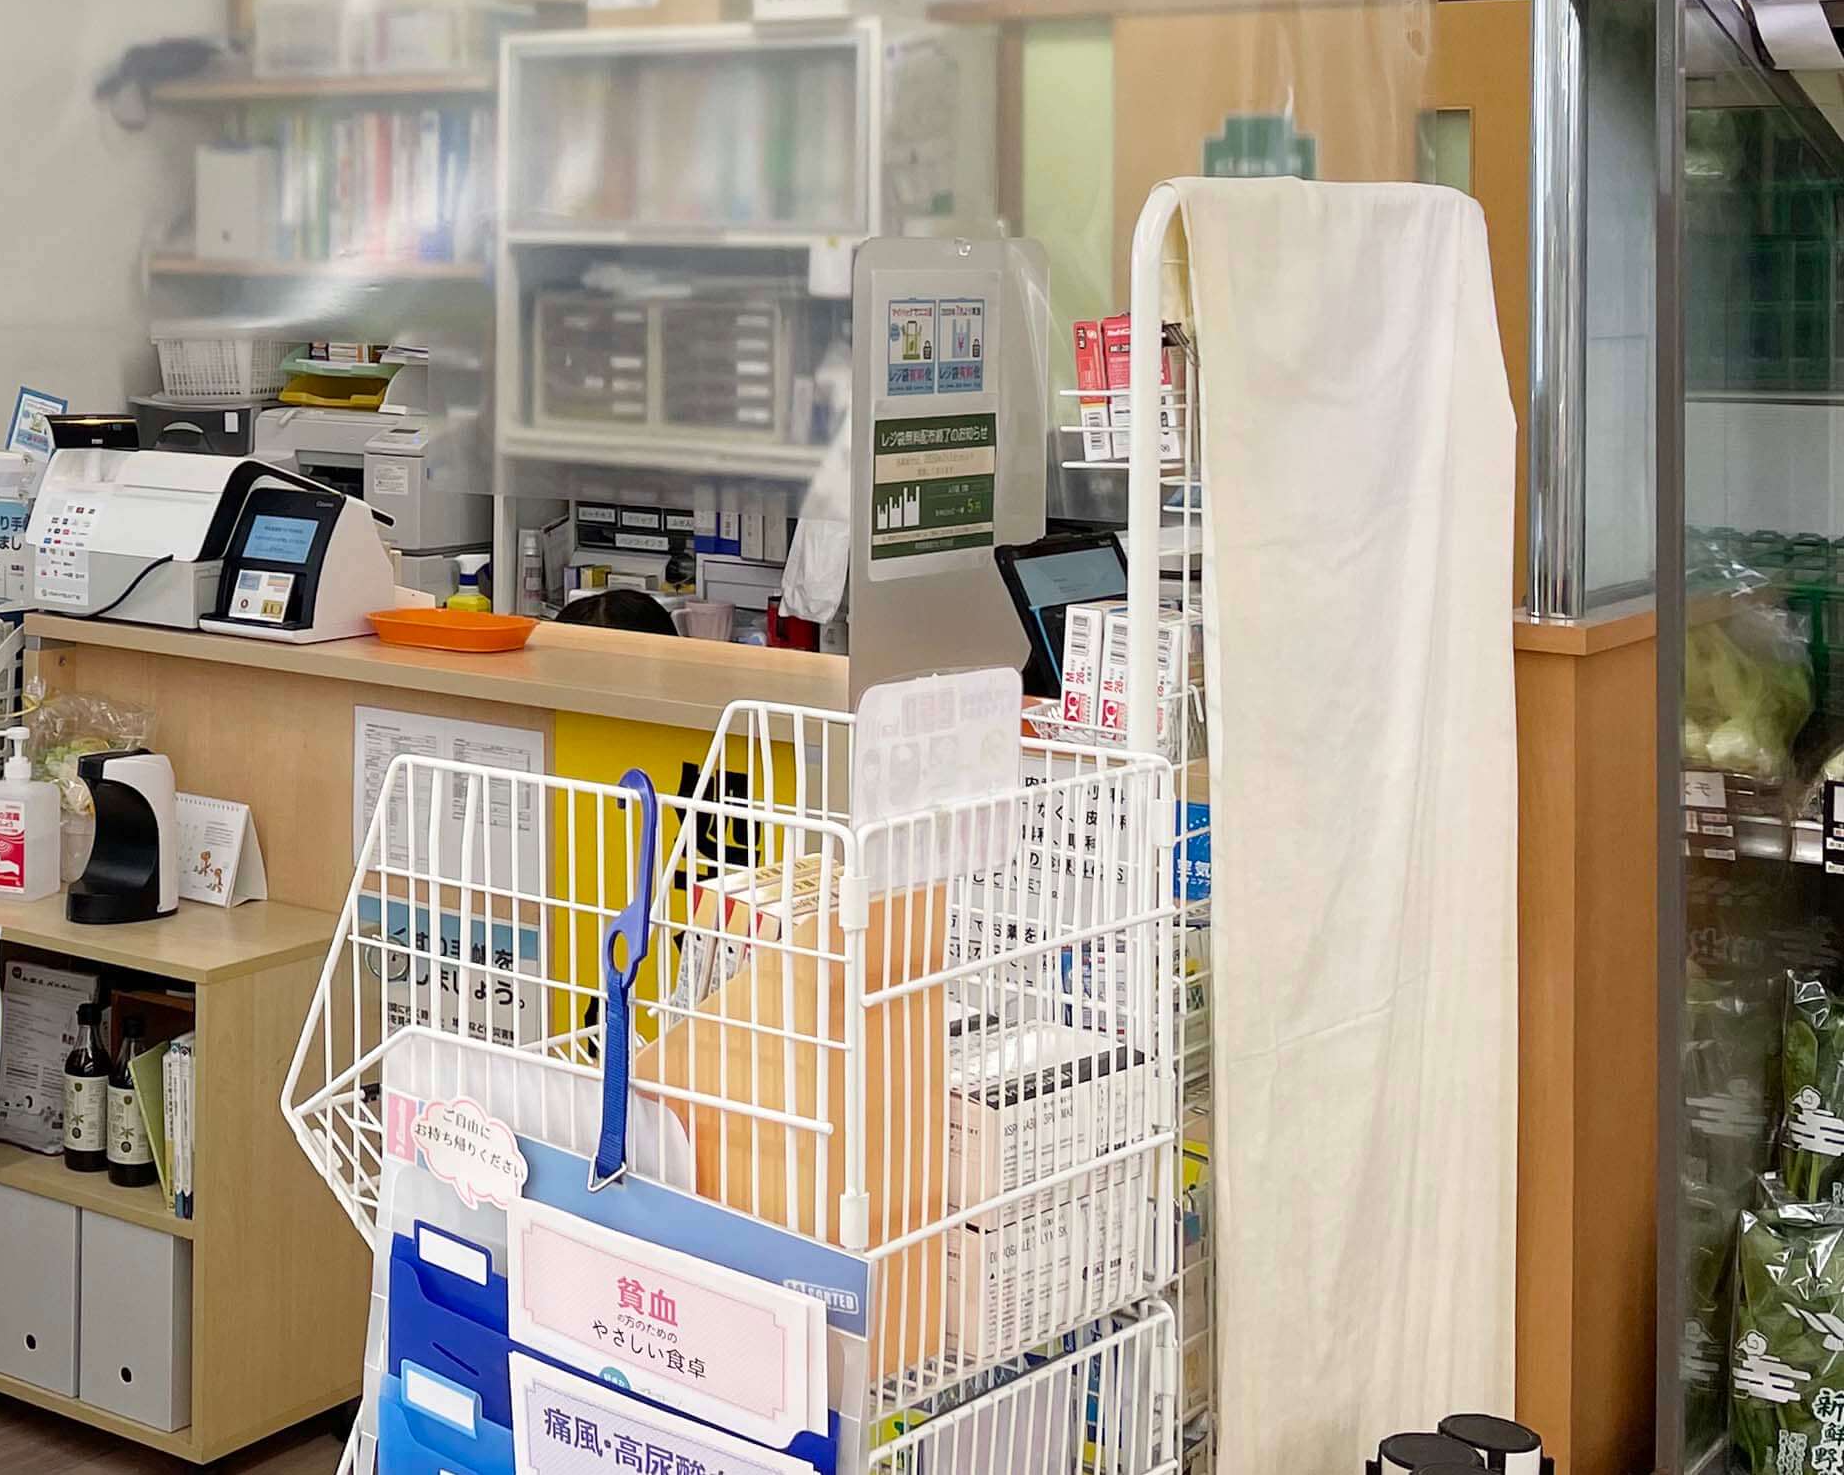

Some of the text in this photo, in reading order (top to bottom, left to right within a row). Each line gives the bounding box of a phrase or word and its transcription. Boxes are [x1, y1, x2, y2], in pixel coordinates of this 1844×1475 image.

[414, 1122, 525, 1181] お持ち帰りください
[441, 1108, 492, 1141] ご自由に
[616, 1276, 679, 1328] 貧血
[616, 1312, 679, 1345] の方のための
[591, 1319, 707, 1379] やさしい食卓
[543, 1406, 725, 1475] 痛風・高尿酸
